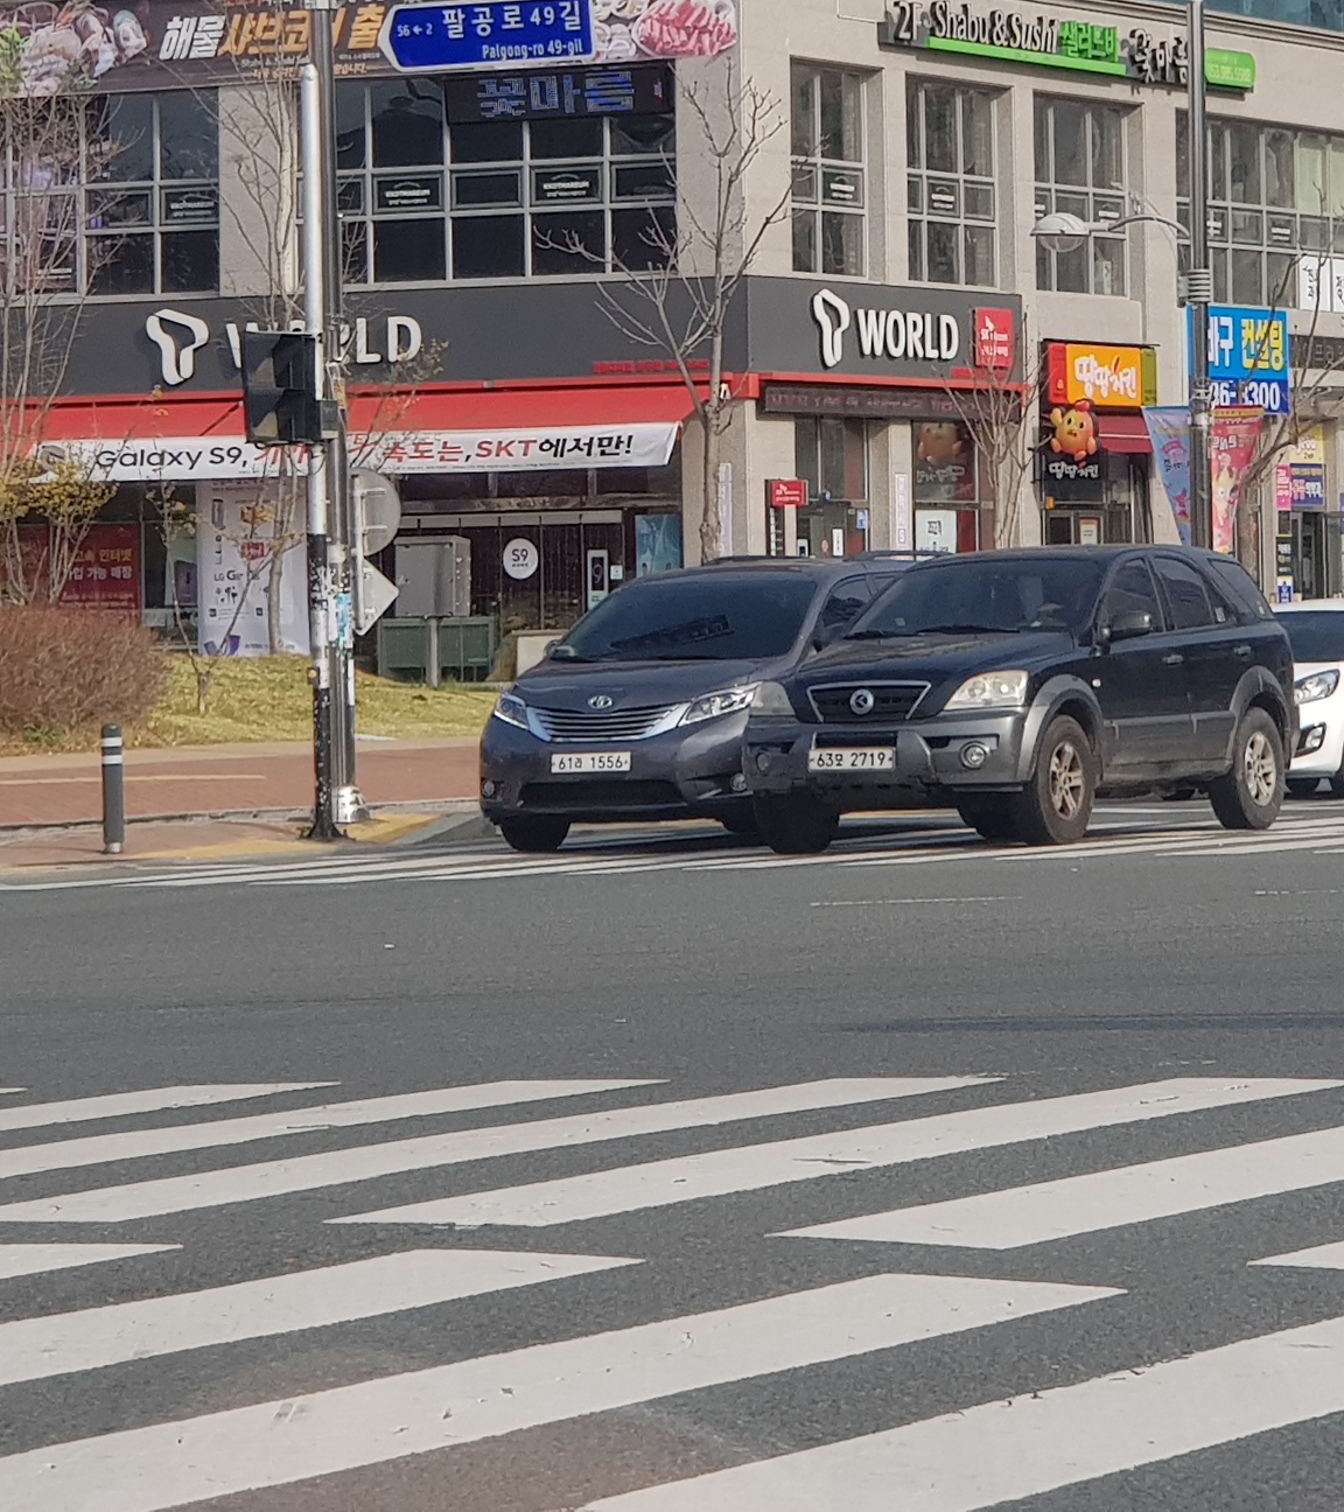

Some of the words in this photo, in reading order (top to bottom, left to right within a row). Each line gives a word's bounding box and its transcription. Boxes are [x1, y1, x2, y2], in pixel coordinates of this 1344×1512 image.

[425, 23, 434, 36] 2
[893, 0, 923, 41] 2F
[934, 0, 988, 45] Shabu
[993, 9, 1009, 48] &
[1010, 13, 1057, 55] Sushi
[1058, 20, 1119, 62] 샐러드바
[482, 41, 545, 60] Palgong-ro
[547, 37, 584, 58] 49-gil
[476, 70, 635, 118] 꽃마름
[856, 308, 960, 361] WORLD
[1240, 319, 1284, 371] 컨설팅
[95, 445, 204, 472] Galaxy
[510, 548, 529, 565] S9
[590, 756, 624, 769] 1556
[850, 751, 887, 767] 2719
